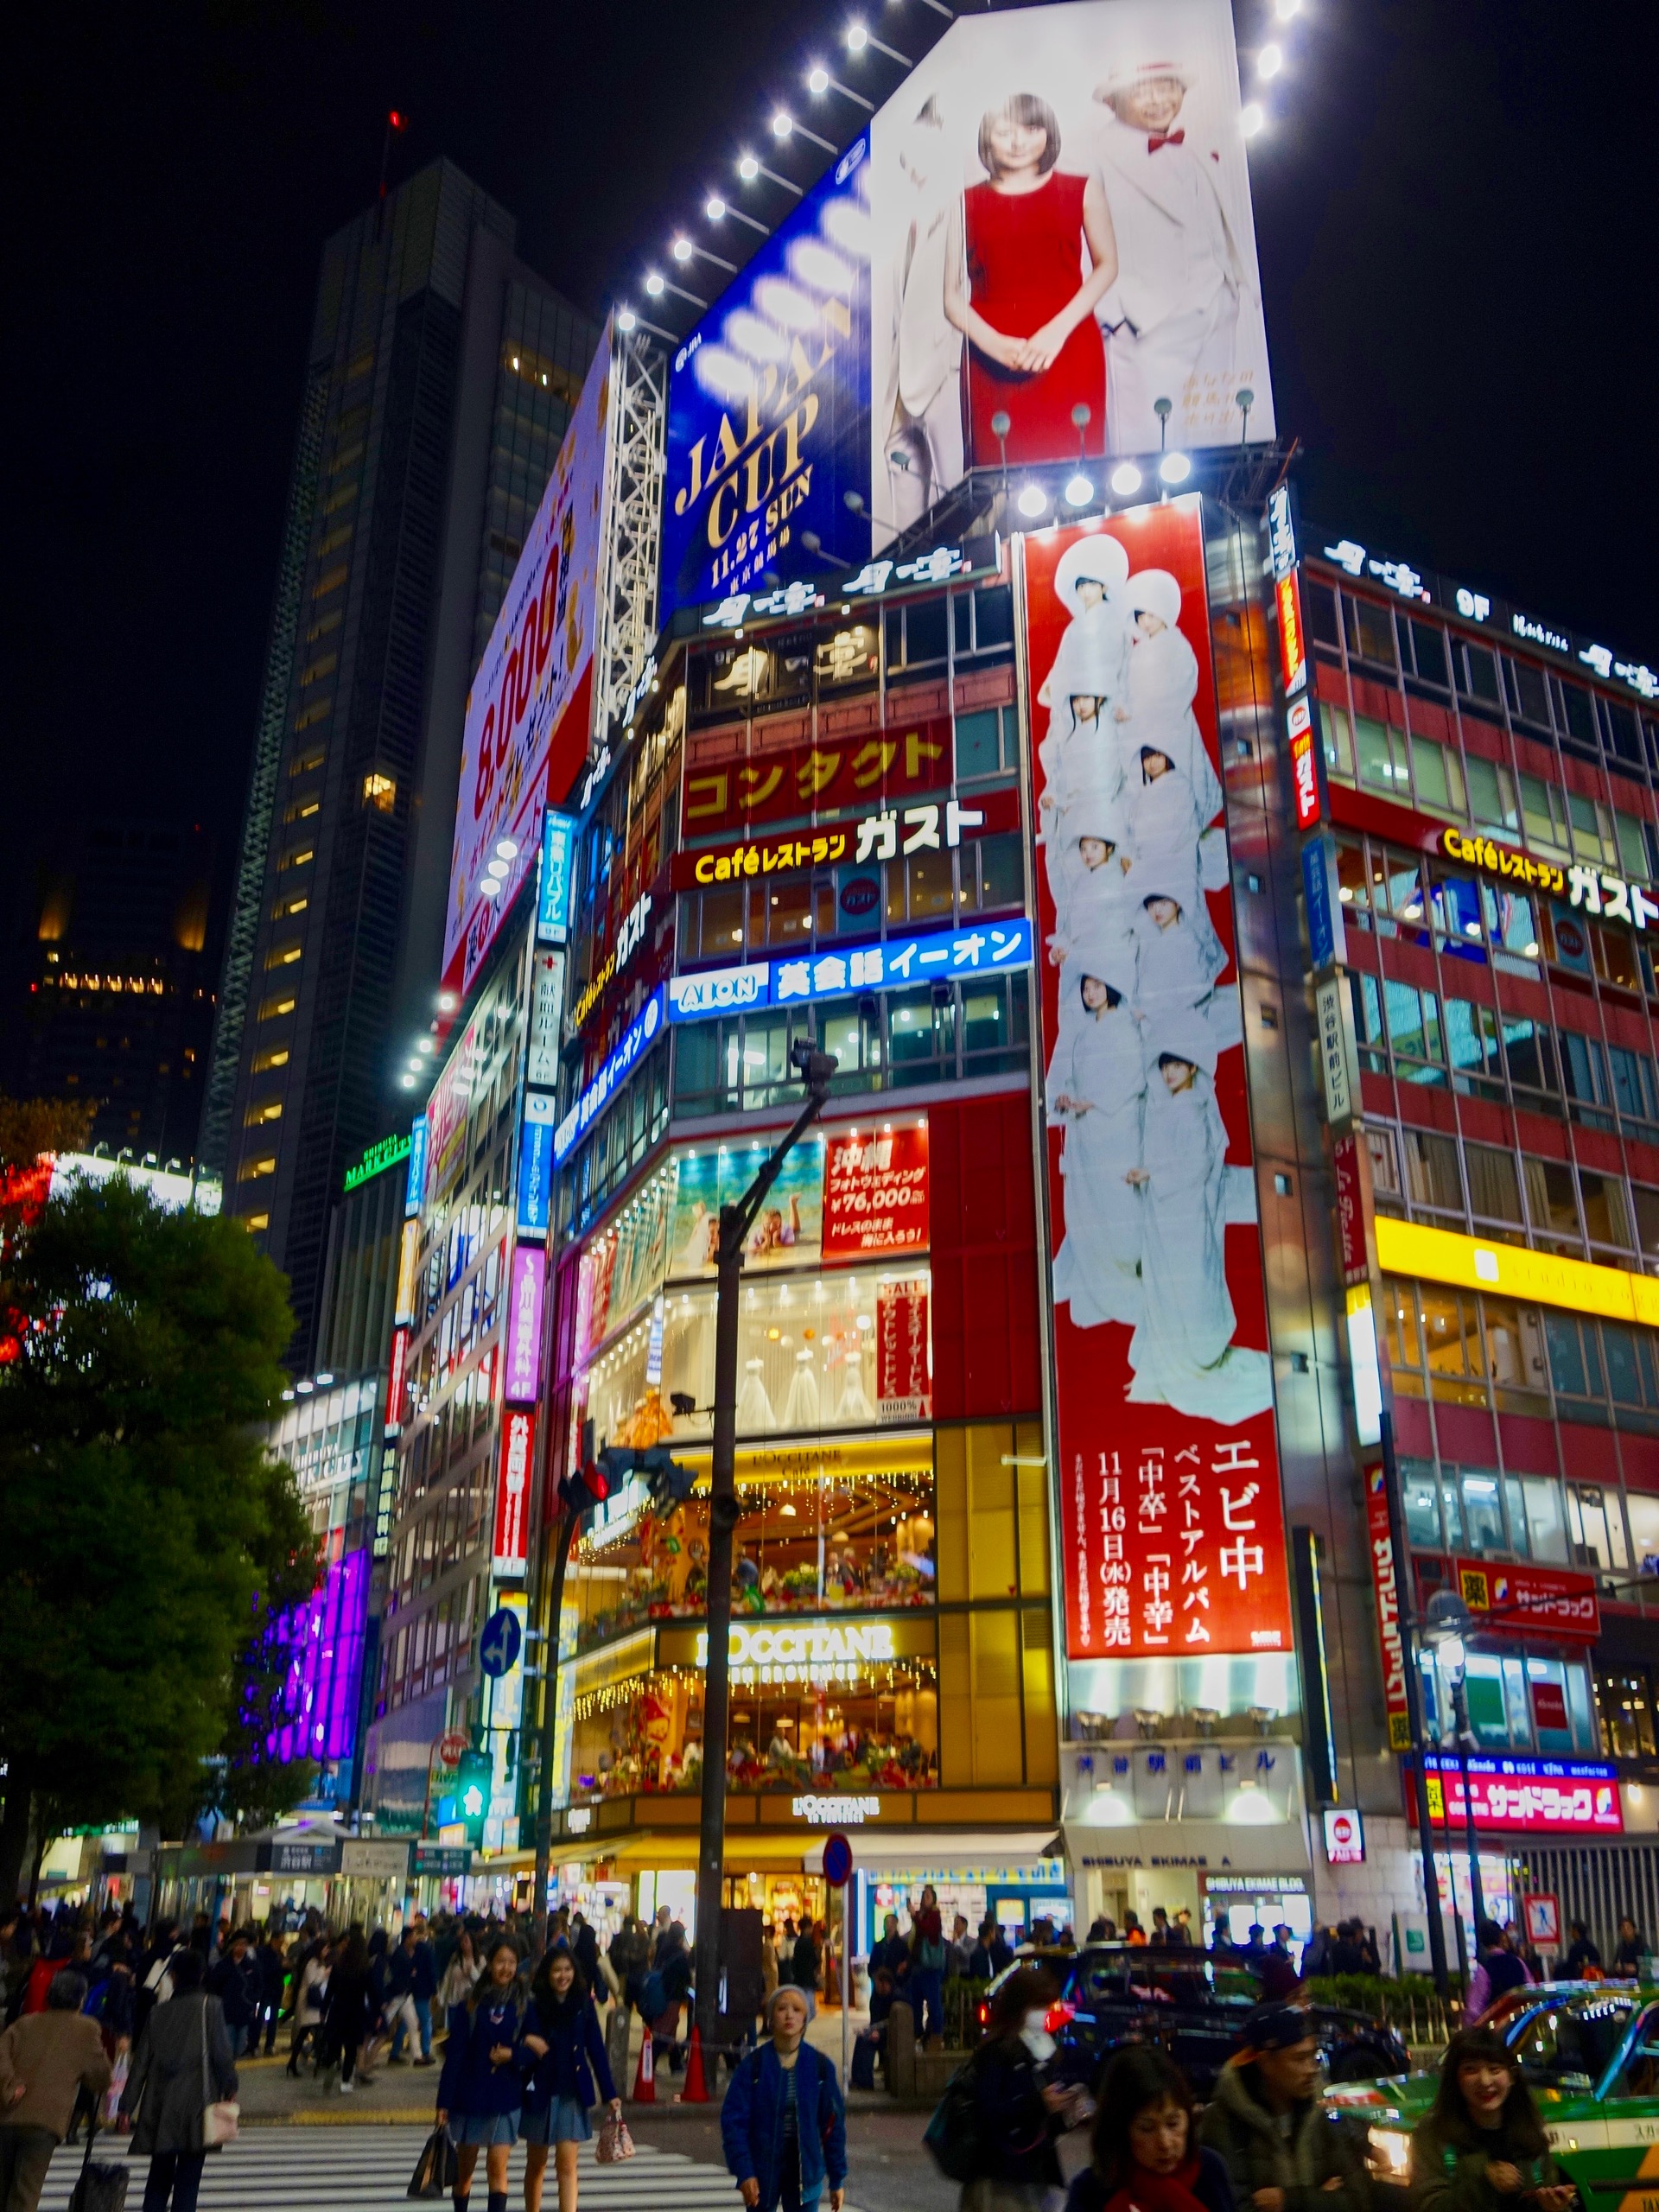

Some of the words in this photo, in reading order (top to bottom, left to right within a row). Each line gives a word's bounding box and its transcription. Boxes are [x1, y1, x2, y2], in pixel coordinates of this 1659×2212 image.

[675, 298, 851, 516] JAPAN
[708, 394, 818, 549] CUP
[711, 518, 760, 589] 11.27
[766, 463, 813, 536] SUN
[1456, 588, 1490, 621] 9F
[474, 541, 560, 823] 8,000
[688, 732, 943, 820] コンタクト
[856, 801, 983, 864] ガスト
[616, 892, 652, 975] ガスト
[1568, 865, 1659, 929] ガスト
[778, 930, 1022, 1000] 英会話イーオン
[537, 981, 556, 1066] 献血ルーム
[1322, 994, 1344, 1110] 渋谷駅前ビル
[831, 1139, 893, 1178] 沖縄
[831, 1186, 912, 1214] ¥76,000
[1174, 1443, 1210, 1643] ベストアルバム
[1211, 1440, 1264, 1591] エビ中
[696, 1624, 894, 1667] LOCCITANE
[1486, 1783, 1592, 1821] サンドラッグ
[1082, 1854, 1143, 1868] SHIBUYA
[1205, 1876, 1245, 1892] SHIBUYA
